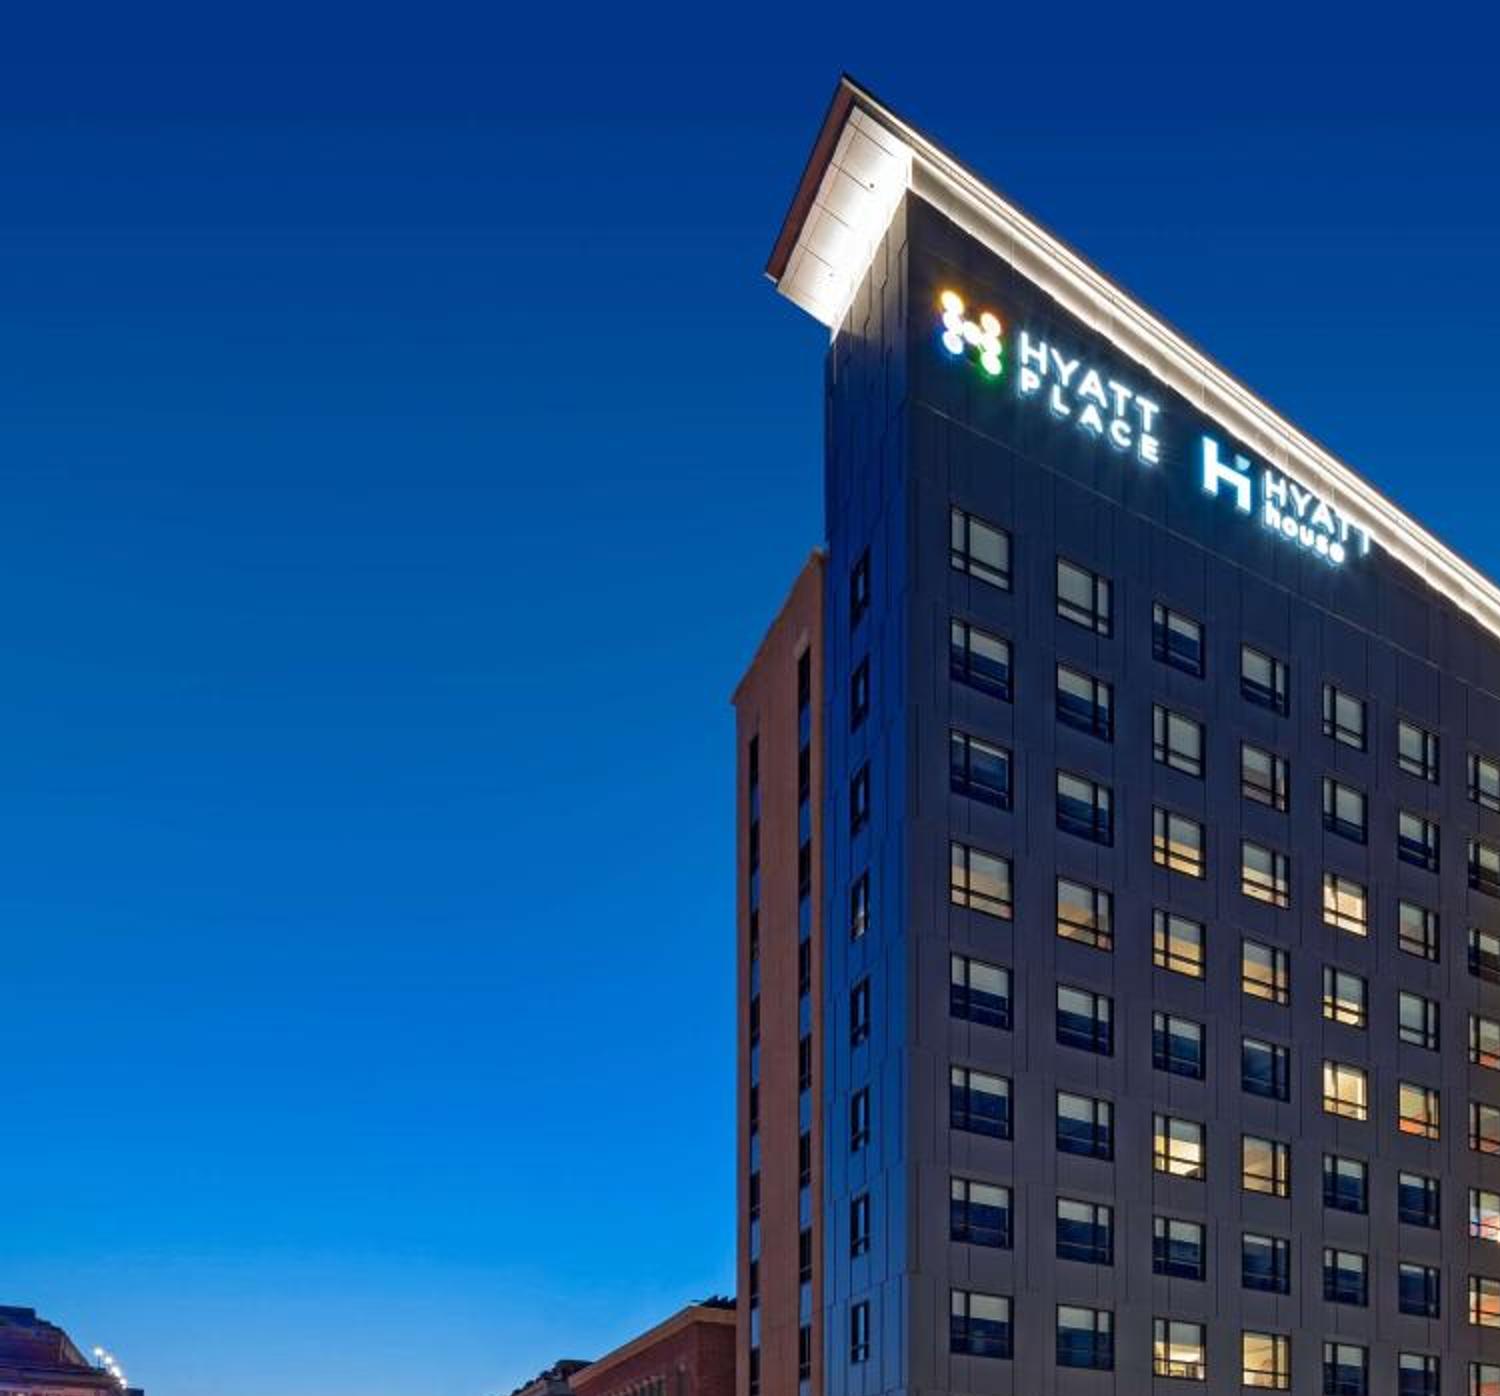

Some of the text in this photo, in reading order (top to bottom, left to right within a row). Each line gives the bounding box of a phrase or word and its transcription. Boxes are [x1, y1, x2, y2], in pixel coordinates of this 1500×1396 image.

[1021, 330, 1160, 433] HYATT
[1021, 367, 1160, 464] PLACE
[1264, 469, 1371, 554] HYATT
